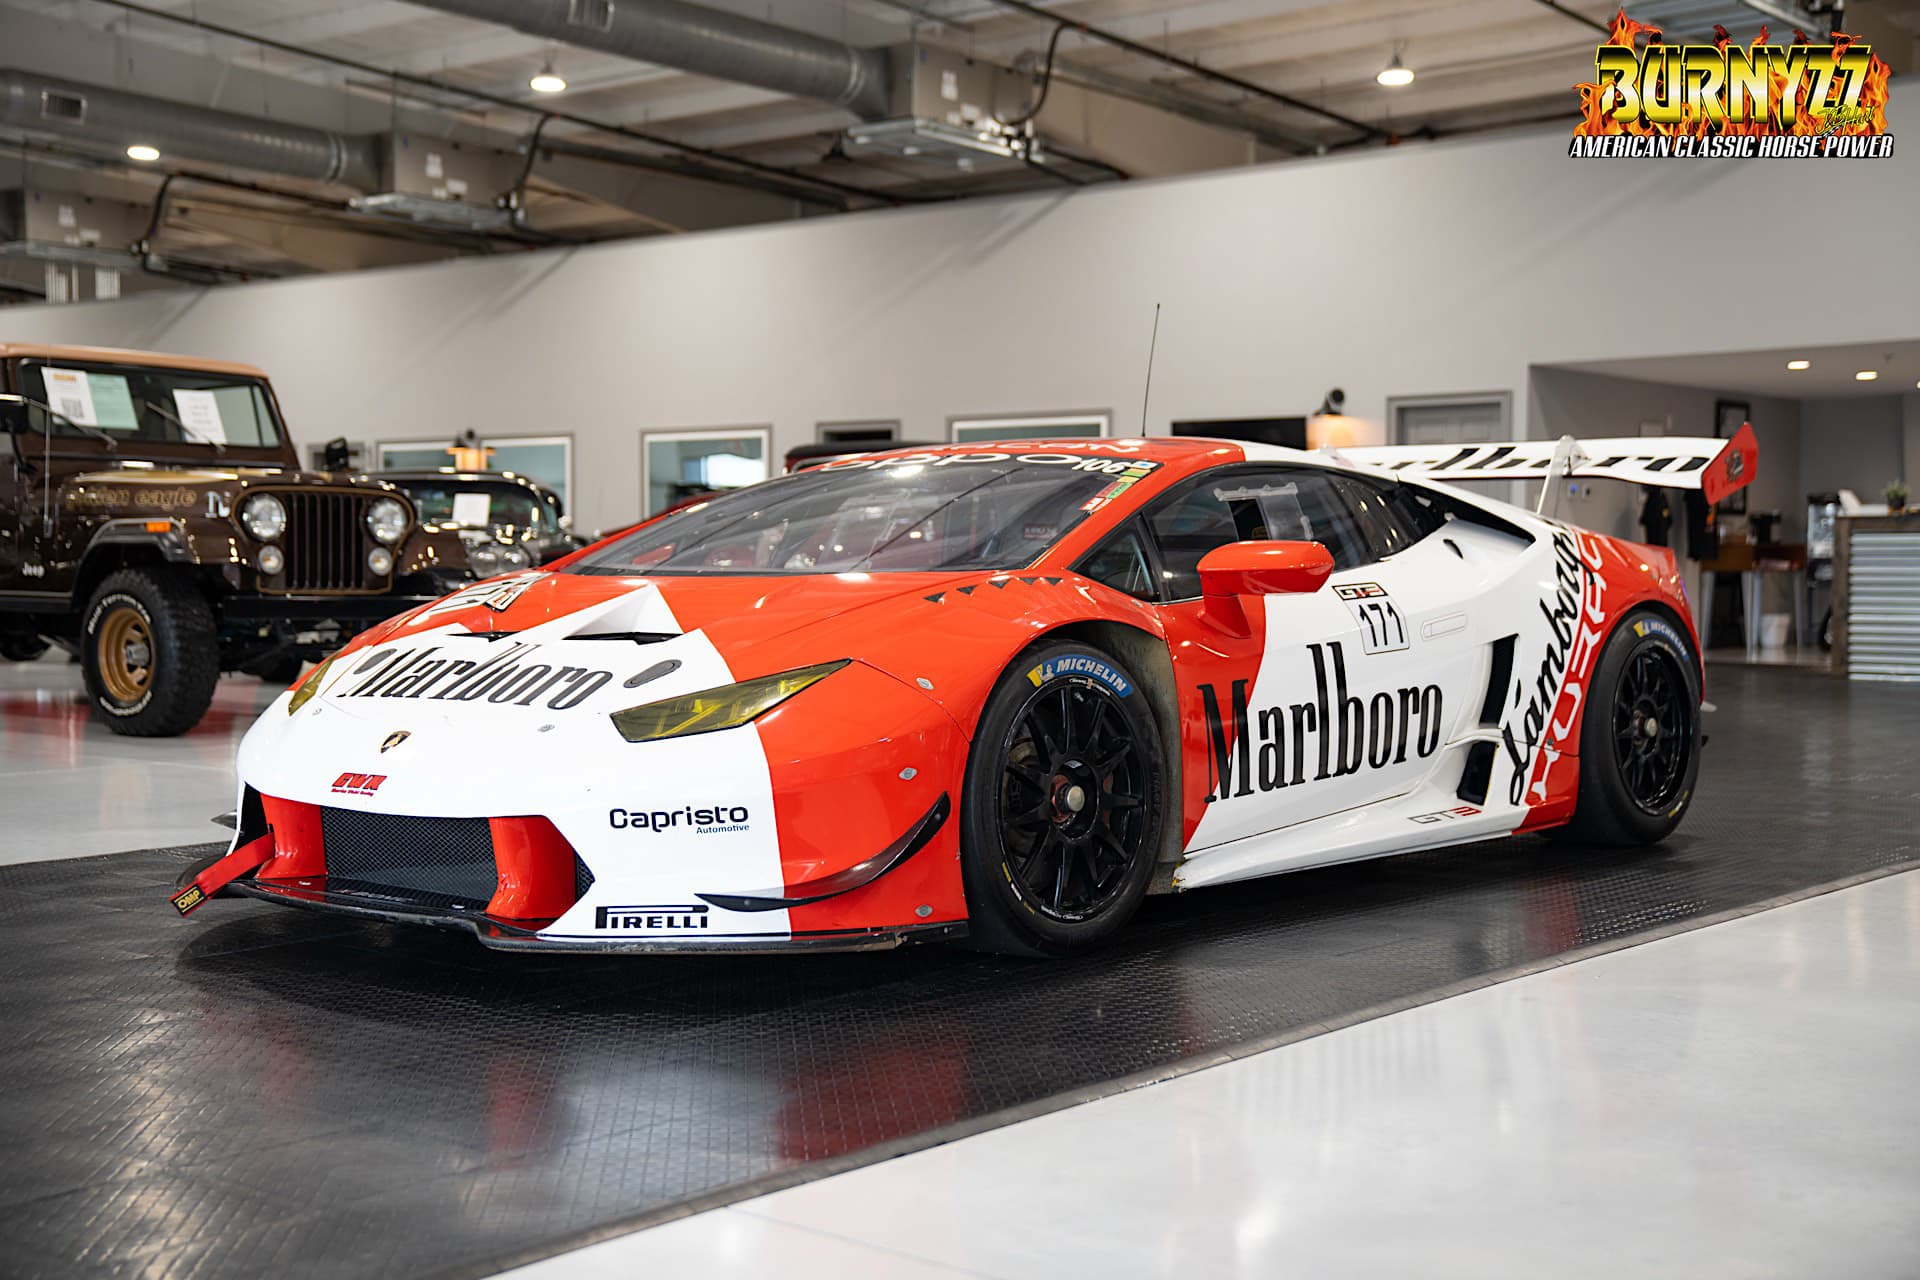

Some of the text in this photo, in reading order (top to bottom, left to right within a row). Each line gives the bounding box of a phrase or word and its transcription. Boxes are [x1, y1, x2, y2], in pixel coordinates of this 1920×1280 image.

[135, 487, 197, 512] eagle
[22, 561, 45, 579] Jeep
[1358, 600, 1404, 648] 171
[1651, 621, 1688, 657] MICHELIN
[336, 641, 613, 710] Marlboro
[1056, 657, 1128, 692] MICHELIN
[1197, 641, 1443, 803] Marlboro
[610, 806, 748, 833] Capristo
[696, 823, 750, 835] Automotive
[177, 890, 201, 909] OMP
[595, 905, 709, 929] PIRELLI
